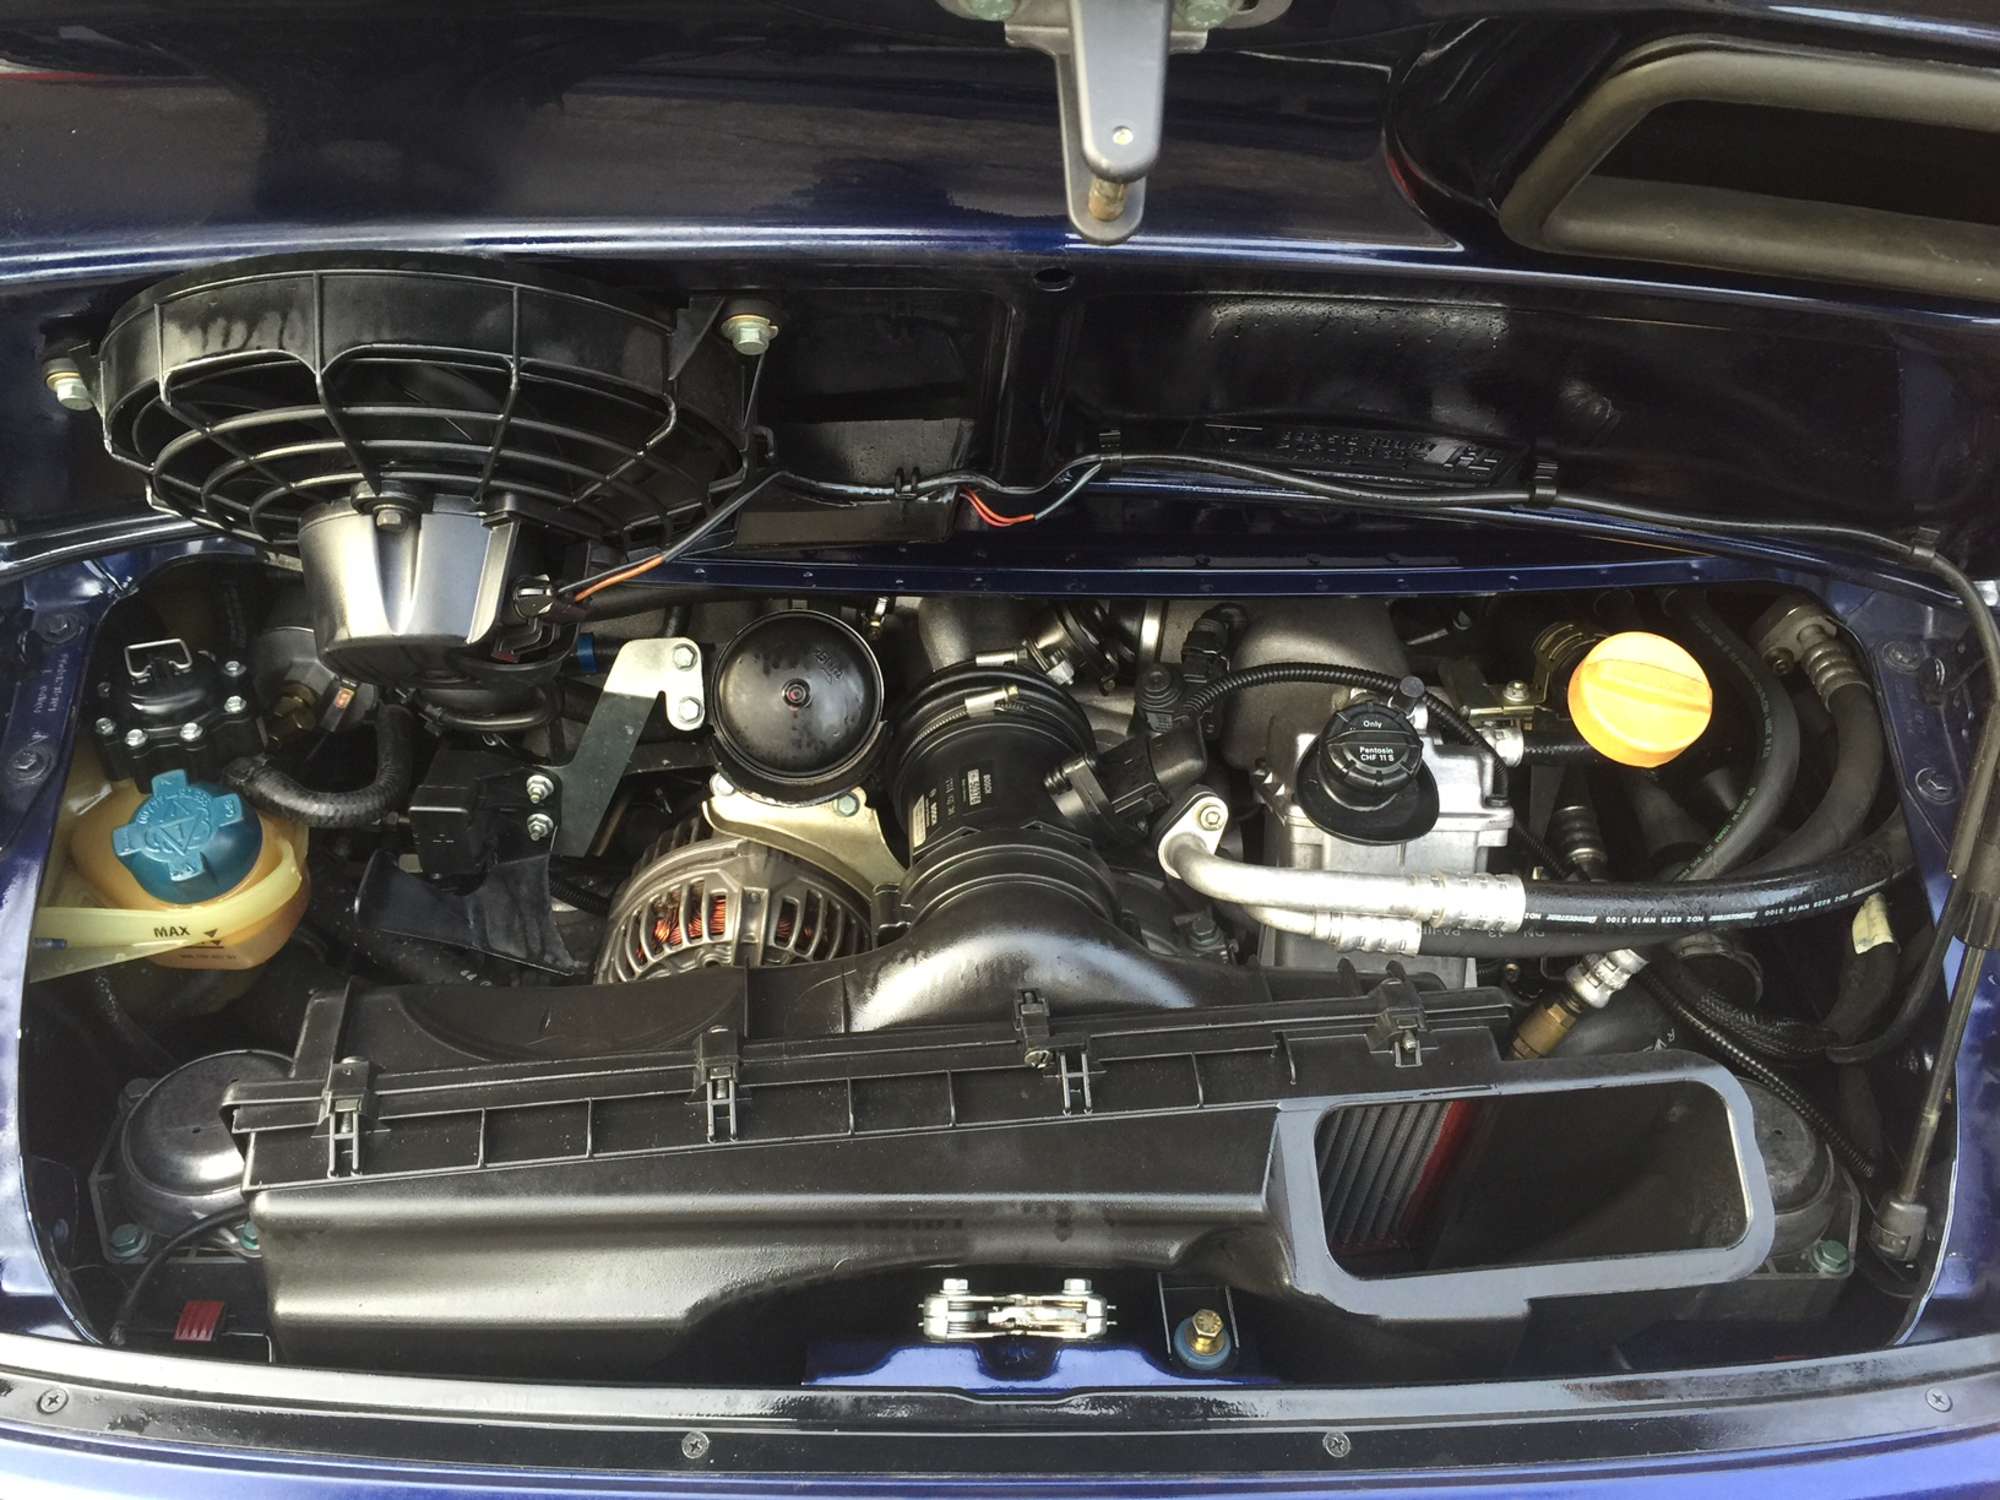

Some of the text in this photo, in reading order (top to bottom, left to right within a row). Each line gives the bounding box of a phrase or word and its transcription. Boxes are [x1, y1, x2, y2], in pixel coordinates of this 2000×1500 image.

[1363, 720, 1382, 728] Only
[1359, 746, 1393, 754] Pentosin
[153, 926, 191, 938] MAX
